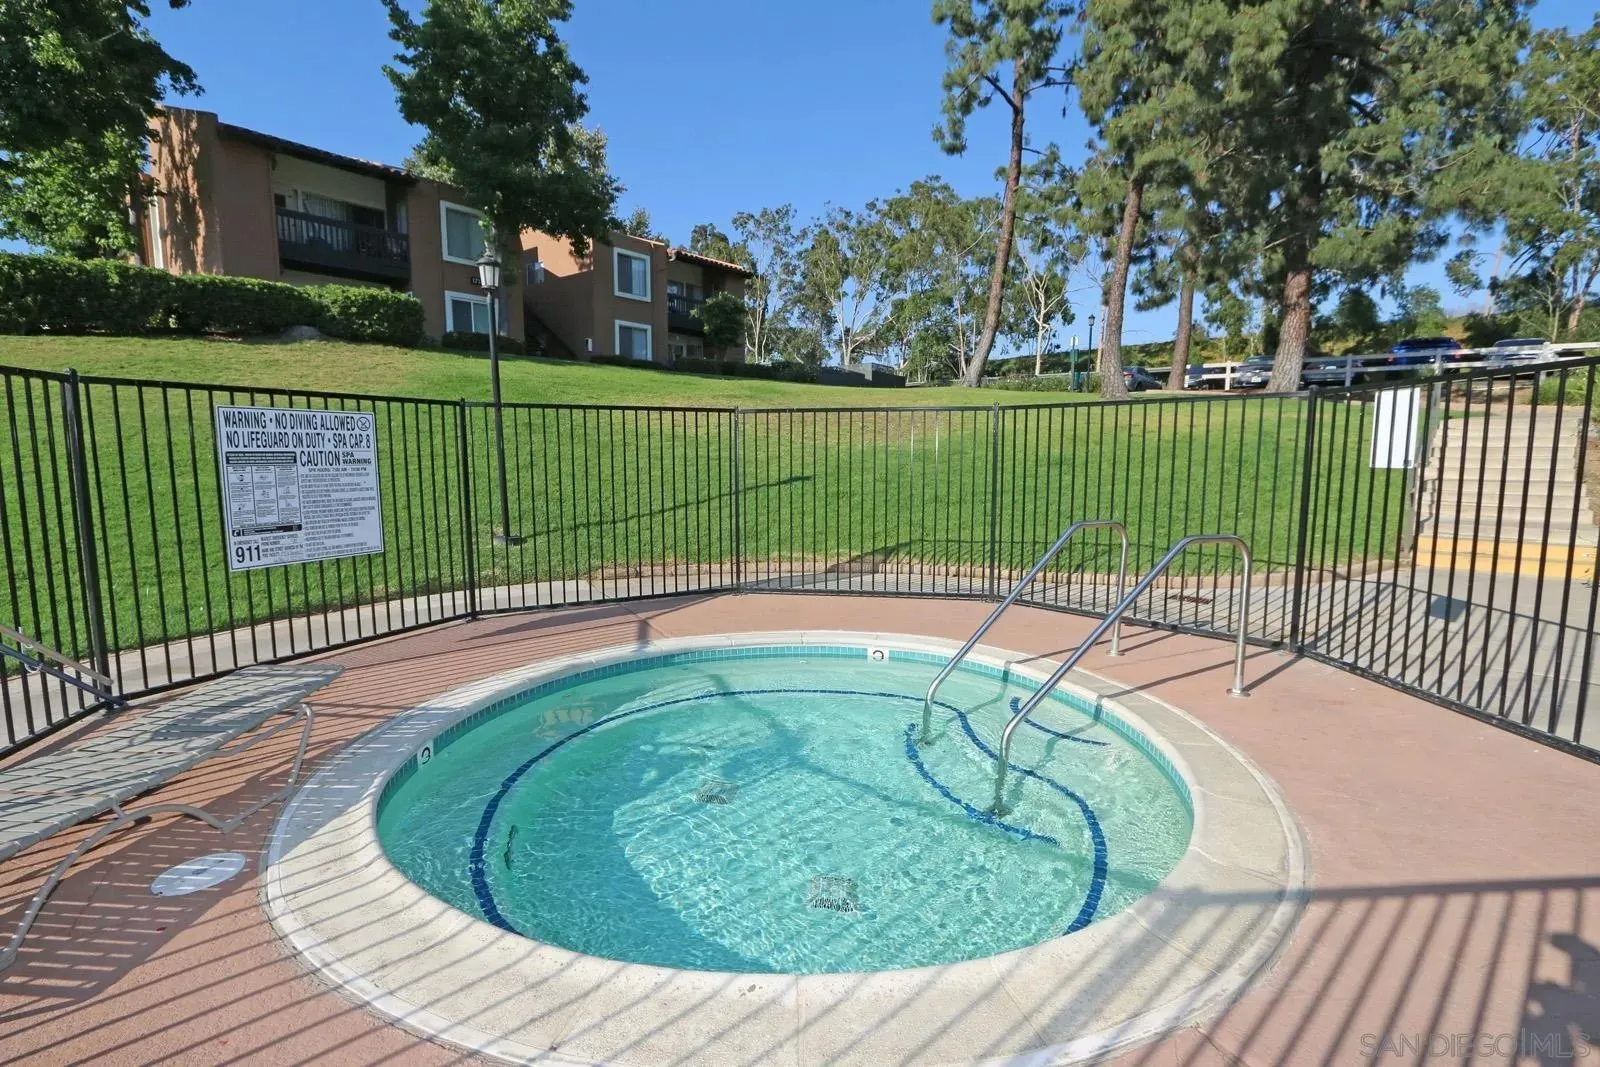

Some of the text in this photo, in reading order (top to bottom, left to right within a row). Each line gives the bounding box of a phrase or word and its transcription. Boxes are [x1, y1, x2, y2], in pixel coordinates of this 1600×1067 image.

[223, 411, 356, 431] WARNING NO DIVING ALLOWED
[226, 431, 371, 449] NO LIFEGUARD ON DUTY SPA CAP. 8
[300, 450, 341, 467] CAUTION
[236, 545, 261, 563] 911
